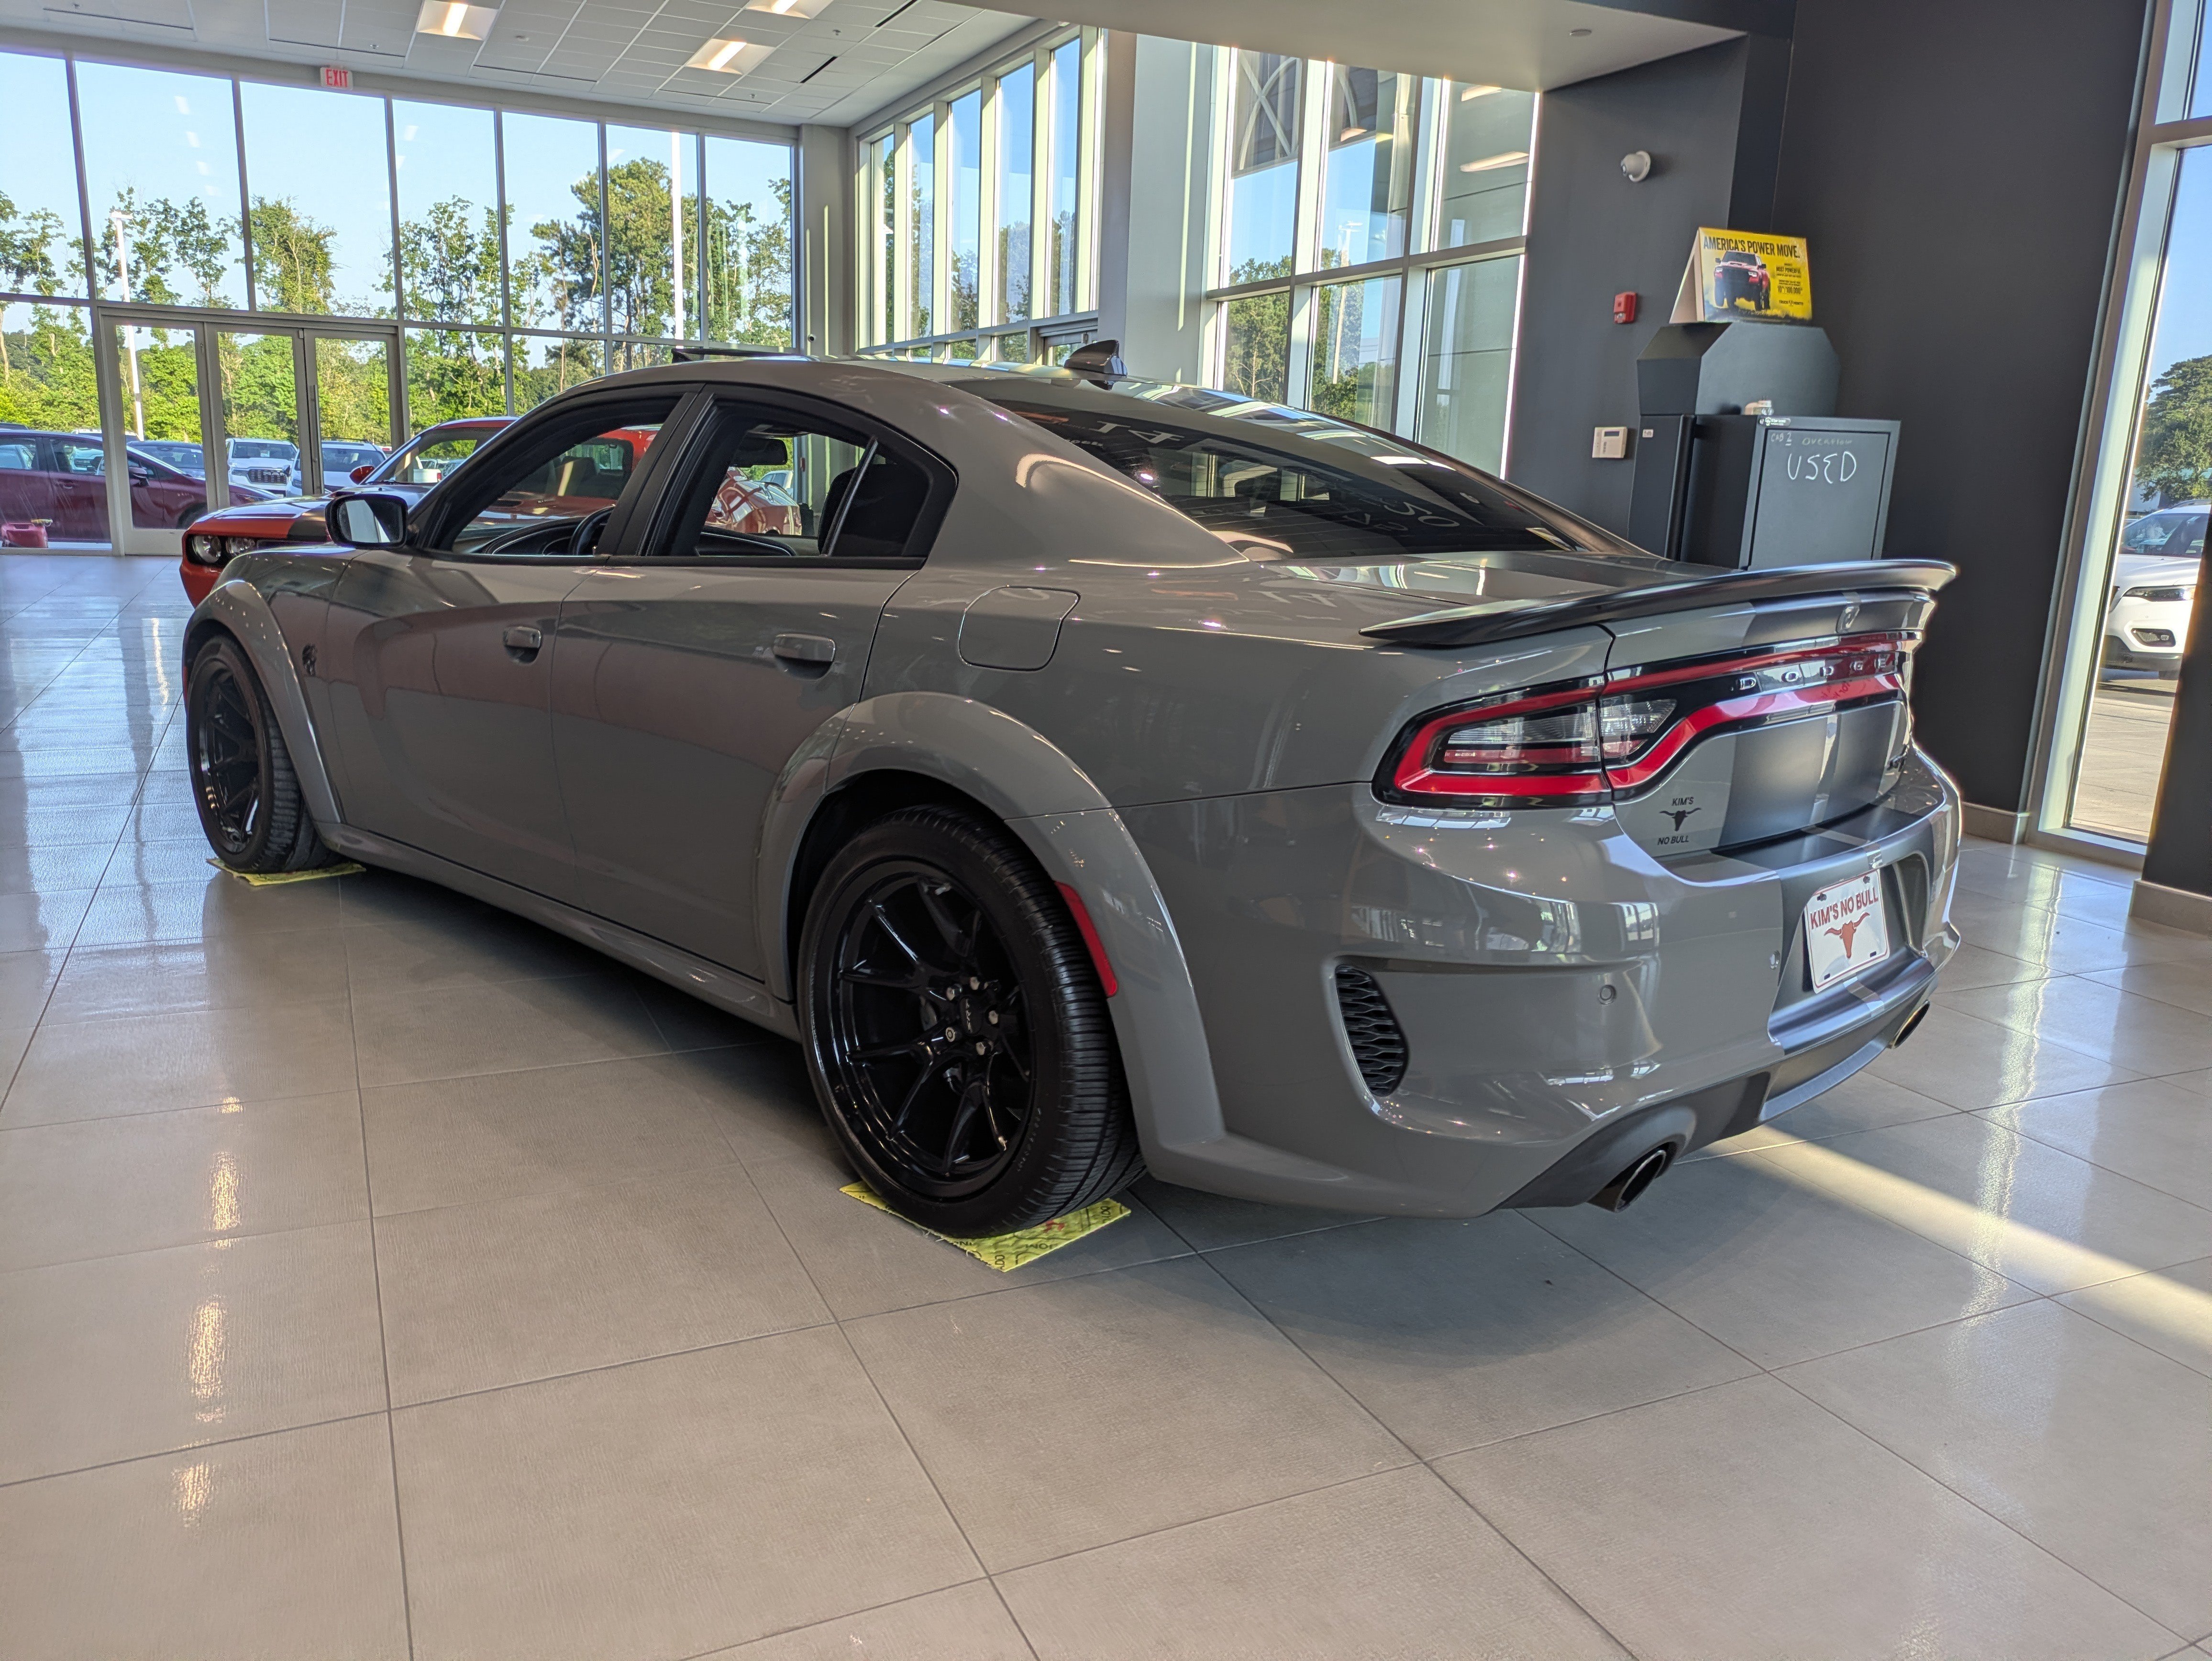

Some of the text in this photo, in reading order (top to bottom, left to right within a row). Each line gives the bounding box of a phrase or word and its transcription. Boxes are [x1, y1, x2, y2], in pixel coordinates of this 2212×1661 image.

[326, 69, 348, 88] EXIT
[1703, 236, 1800, 258] AMERICA'S POWER MOVE.
[1787, 451, 1857, 484] USED
[1739, 656, 1888, 690] DODGE
[1671, 797, 1694, 807] KIM'S
[1657, 835, 1690, 846] NO BULL
[1810, 886, 1879, 930] KIM'S NO BULL
